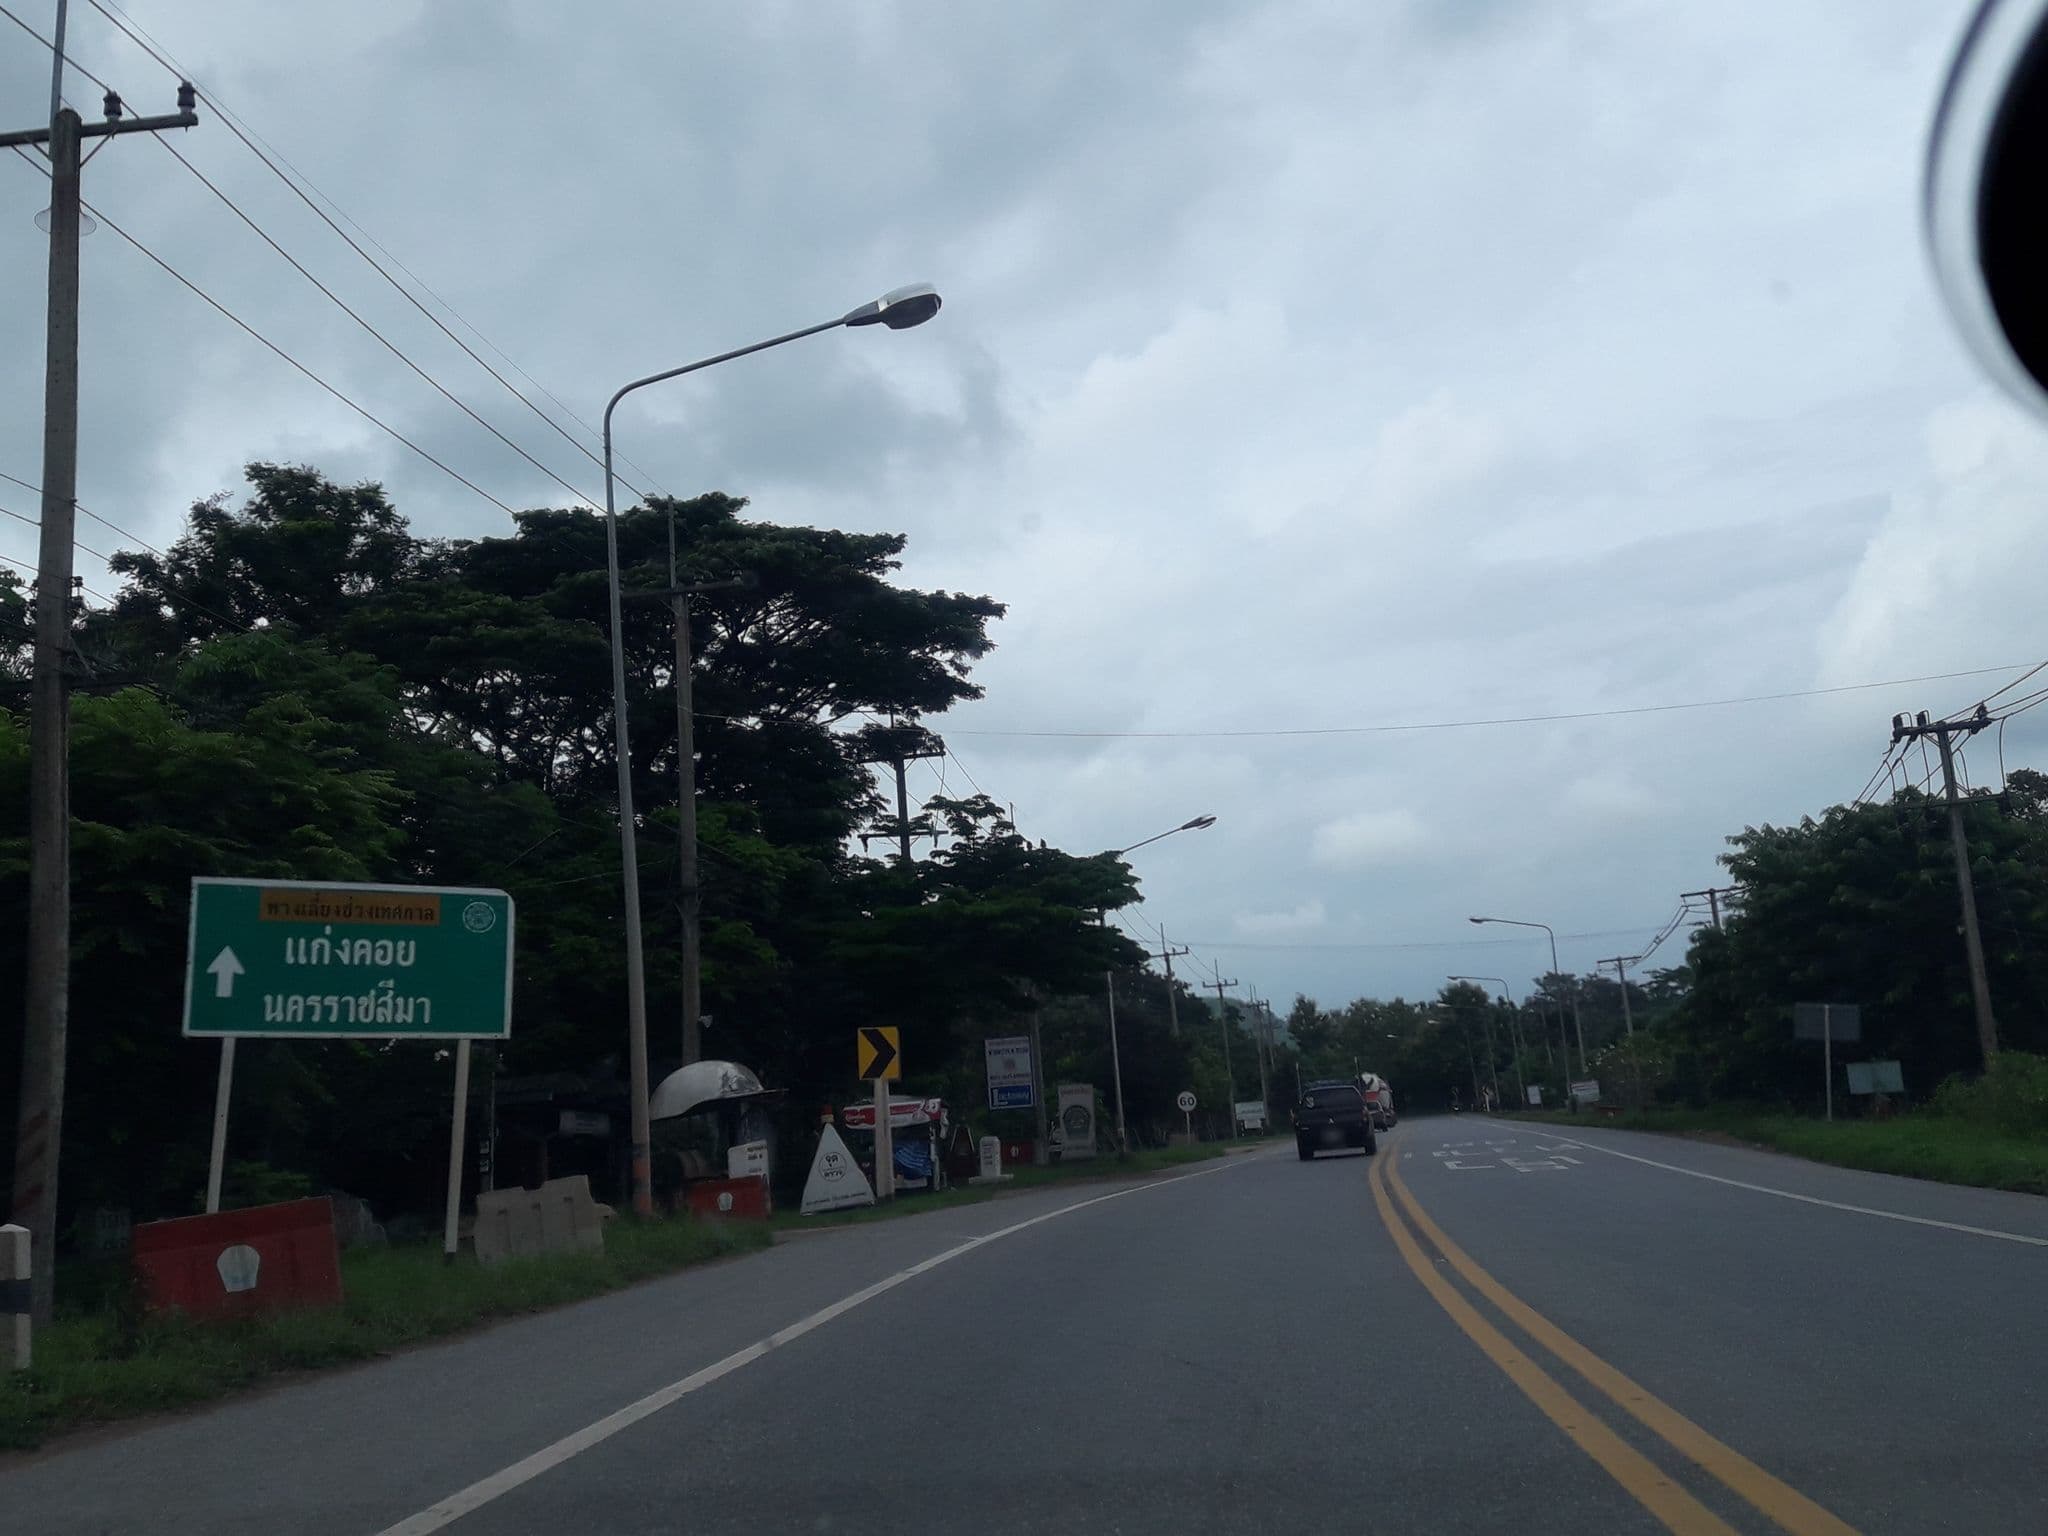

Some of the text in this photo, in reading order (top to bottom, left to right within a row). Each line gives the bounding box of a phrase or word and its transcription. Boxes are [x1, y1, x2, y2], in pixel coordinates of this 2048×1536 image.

[285, 924, 417, 967] แก่งคอย
[264, 978, 432, 1024] นครราชสีมา
[1180, 1096, 1195, 1106] 60
